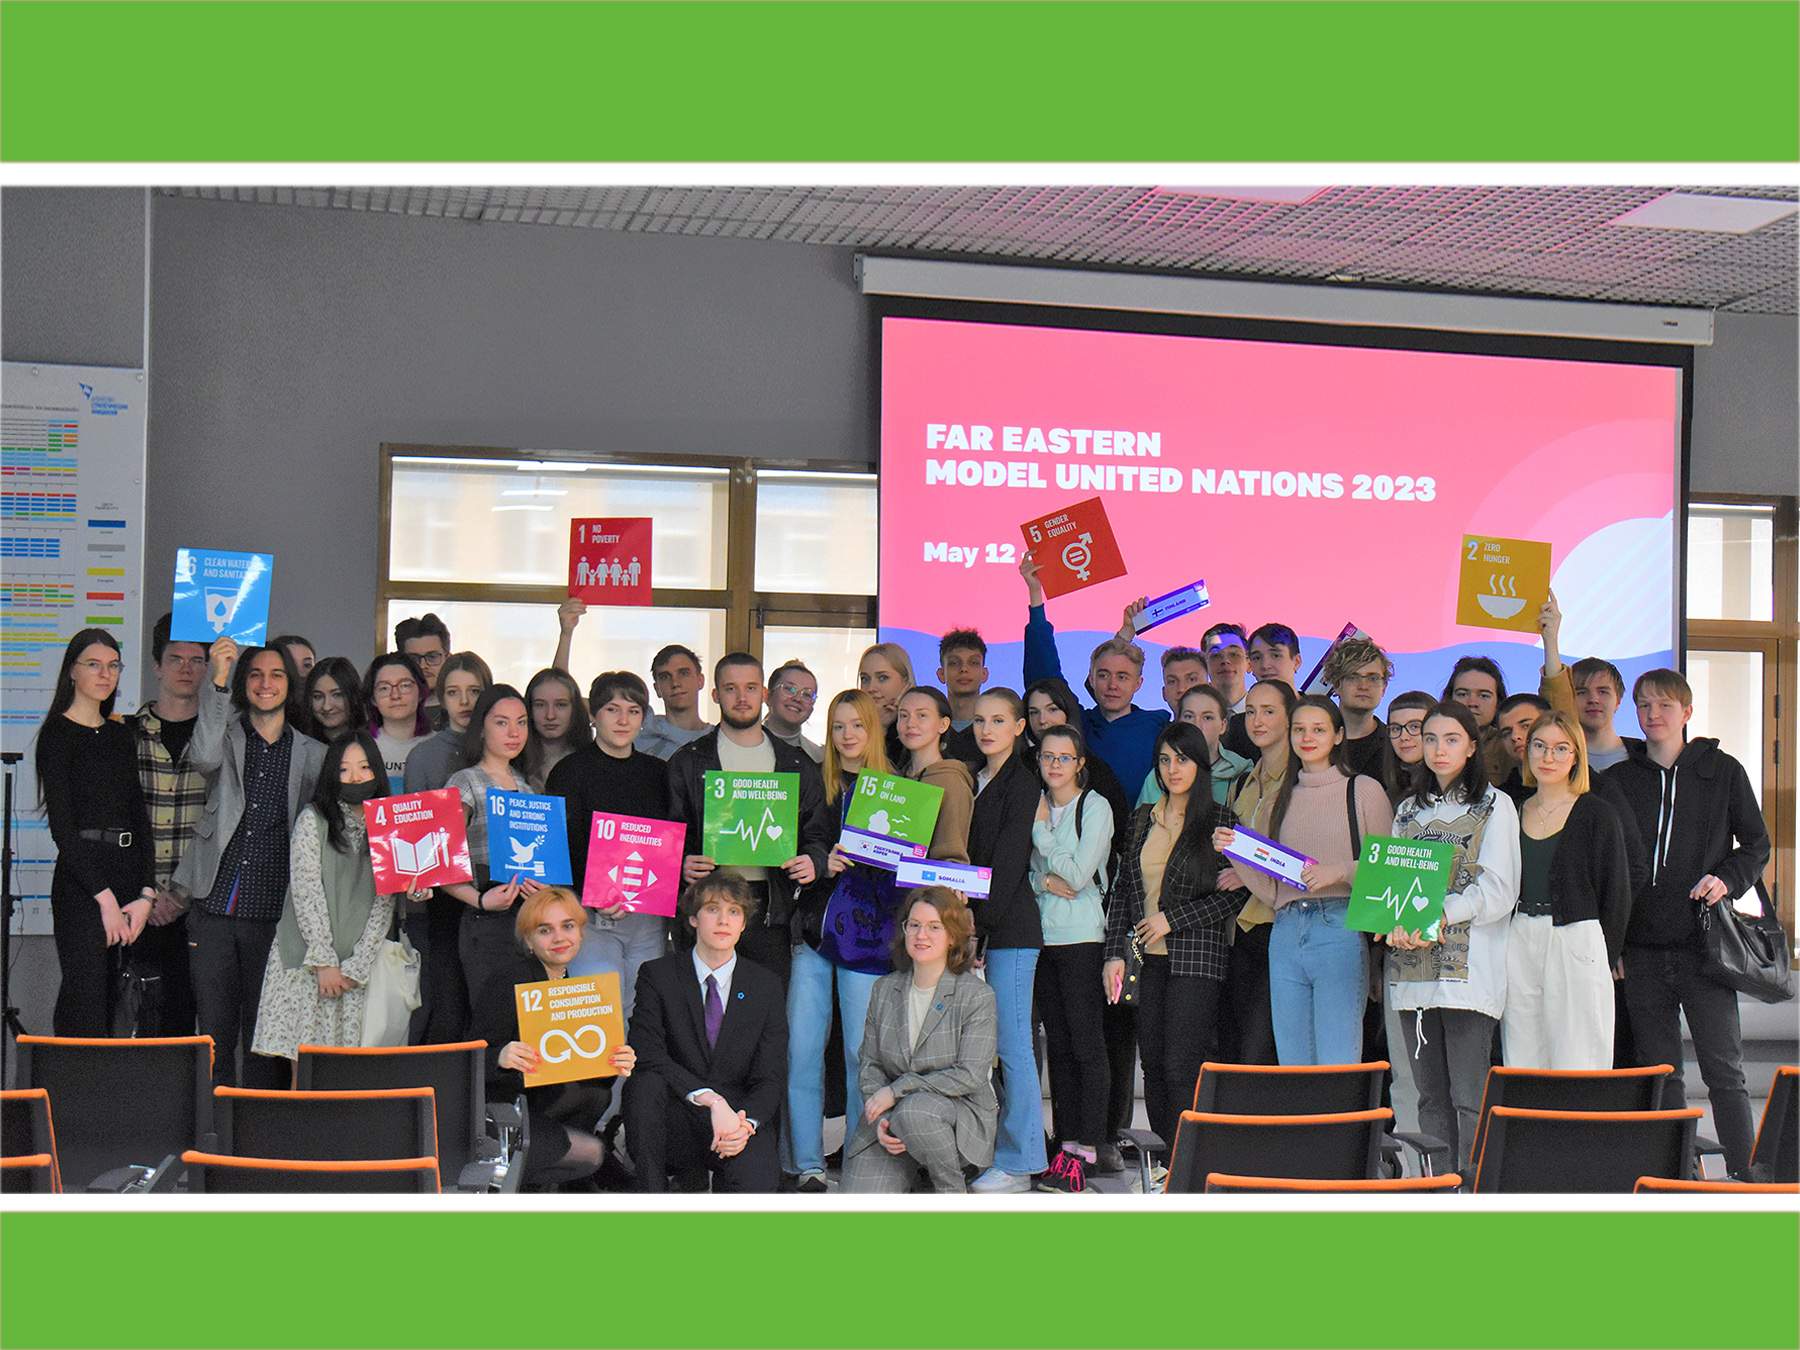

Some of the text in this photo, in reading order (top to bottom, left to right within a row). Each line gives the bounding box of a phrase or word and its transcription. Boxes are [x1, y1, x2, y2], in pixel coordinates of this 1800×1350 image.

[927, 423, 1162, 457] FAR EASTERN
[925, 458, 1437, 502] MODEL UNITED NATIONS 2023
[1044, 514, 1070, 529] GENDER
[579, 524, 586, 543] 1
[1029, 525, 1042, 543] 5
[1047, 521, 1078, 538] EQUALITY
[592, 534, 620, 544] POVERTY
[923, 541, 1017, 568] May 12
[1467, 540, 1478, 560] 2
[1484, 543, 1501, 552] ZERO
[204, 557, 226, 568] CLEAN
[1483, 554, 1511, 565] HUNGER
[203, 567, 218, 578] AND
[714, 778, 725, 798] 3
[732, 778, 778, 789] GOOD HEALTH
[860, 775, 878, 797] 15
[882, 779, 895, 790] LIFE
[733, 789, 787, 801] AND WELL-BEING
[880, 790, 906, 805] ON LAND
[392, 799, 422, 814] QUALITY
[490, 795, 505, 816] 16
[529, 800, 551, 811] JUSTICE
[375, 805, 387, 826] 4
[394, 809, 434, 825] EDUCATION
[509, 809, 546, 821] AND STRONG
[509, 820, 548, 833] INSTITUTIONS
[596, 819, 616, 840] 10
[621, 822, 652, 834] REDUCED
[619, 833, 663, 847] INEQUALITIES
[1368, 843, 1380, 863] 3
[1387, 844, 1432, 858] GOOD HEALTH
[1385, 857, 1440, 871] AND WELL-BEING
[938, 875, 966, 884] SOMALIA
[548, 982, 596, 997] RESPONSIBLE
[521, 989, 543, 1012] 12
[549, 994, 601, 1009] CONSUMPTION
[551, 1004, 613, 1021] AND PRODUCTION
